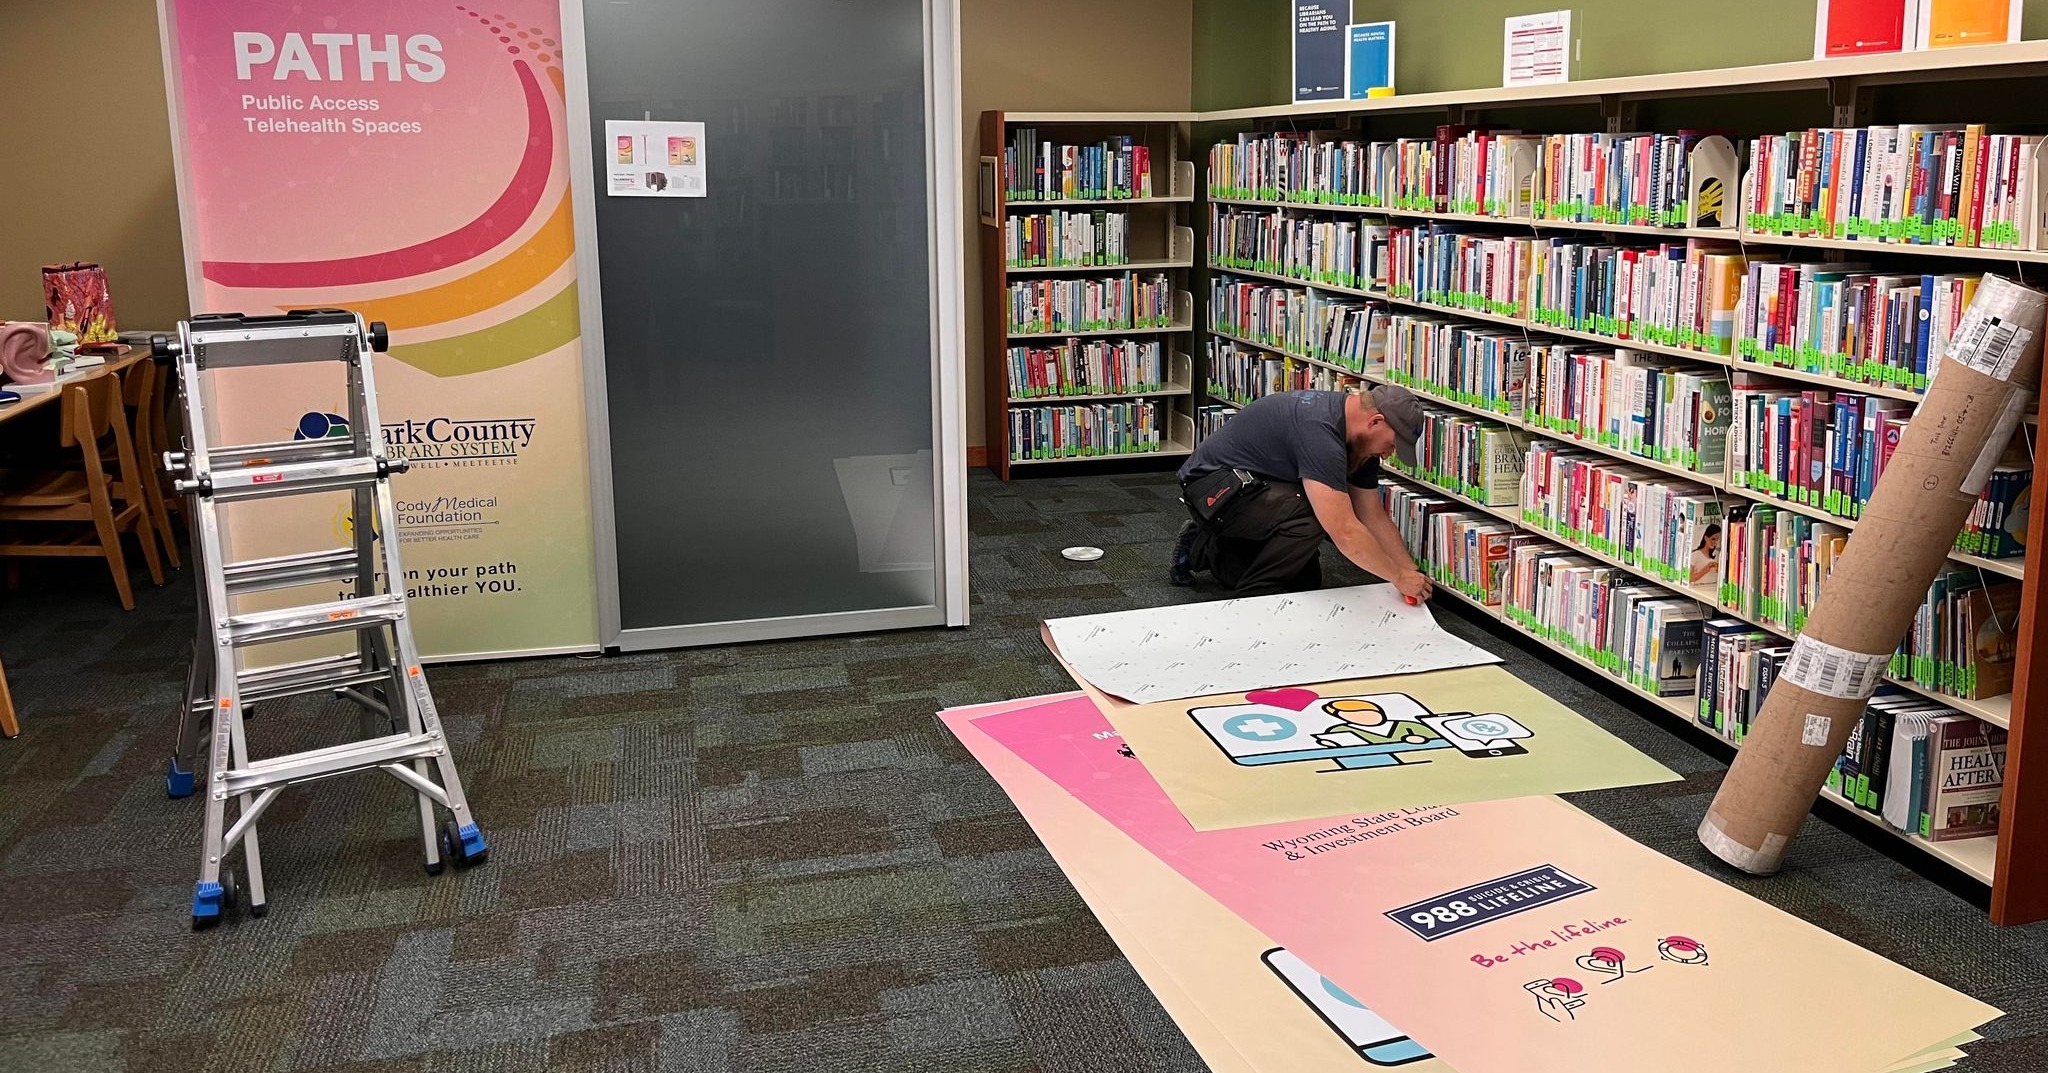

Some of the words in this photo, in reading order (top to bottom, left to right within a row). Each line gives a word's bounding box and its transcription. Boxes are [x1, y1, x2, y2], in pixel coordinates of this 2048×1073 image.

[233, 31, 446, 83] PATHS
[242, 94, 304, 111] Public
[309, 95, 380, 111] Access
[244, 117, 346, 133] Telehealth
[352, 119, 421, 135] Spaces
[1806, 147, 1816, 170] EDGE
[1865, 139, 1873, 174] LONGEVITY
[1954, 148, 1963, 171] DYING
[1952, 171, 1960, 193] WELL
[1633, 353, 1652, 363] THE
[386, 445, 443, 460] BRARY
[451, 441, 516, 456] SYSTEM
[396, 500, 431, 513] Cody
[432, 497, 497, 512] Medical
[398, 510, 482, 525] Foundation
[427, 566, 468, 581] your
[476, 561, 517, 578] path
[475, 579, 522, 593] YOU.
[1944, 738, 1960, 748] THE
[1943, 769, 1996, 788] AFTER
[1262, 824, 1356, 852] Wyoming
[1351, 811, 1400, 828] State
[1285, 849, 1305, 861] &
[1304, 822, 1407, 855] Investment
[1404, 808, 1460, 827] Board
[1410, 900, 1478, 930] 988
[1468, 885, 1509, 902] SUICIDE
[1509, 882, 1518, 890] &
[1517, 874, 1551, 887] CRISIS
[1477, 879, 1567, 912] LIFELINE
[1470, 953, 1509, 968] Be
[1510, 939, 1557, 956] the
